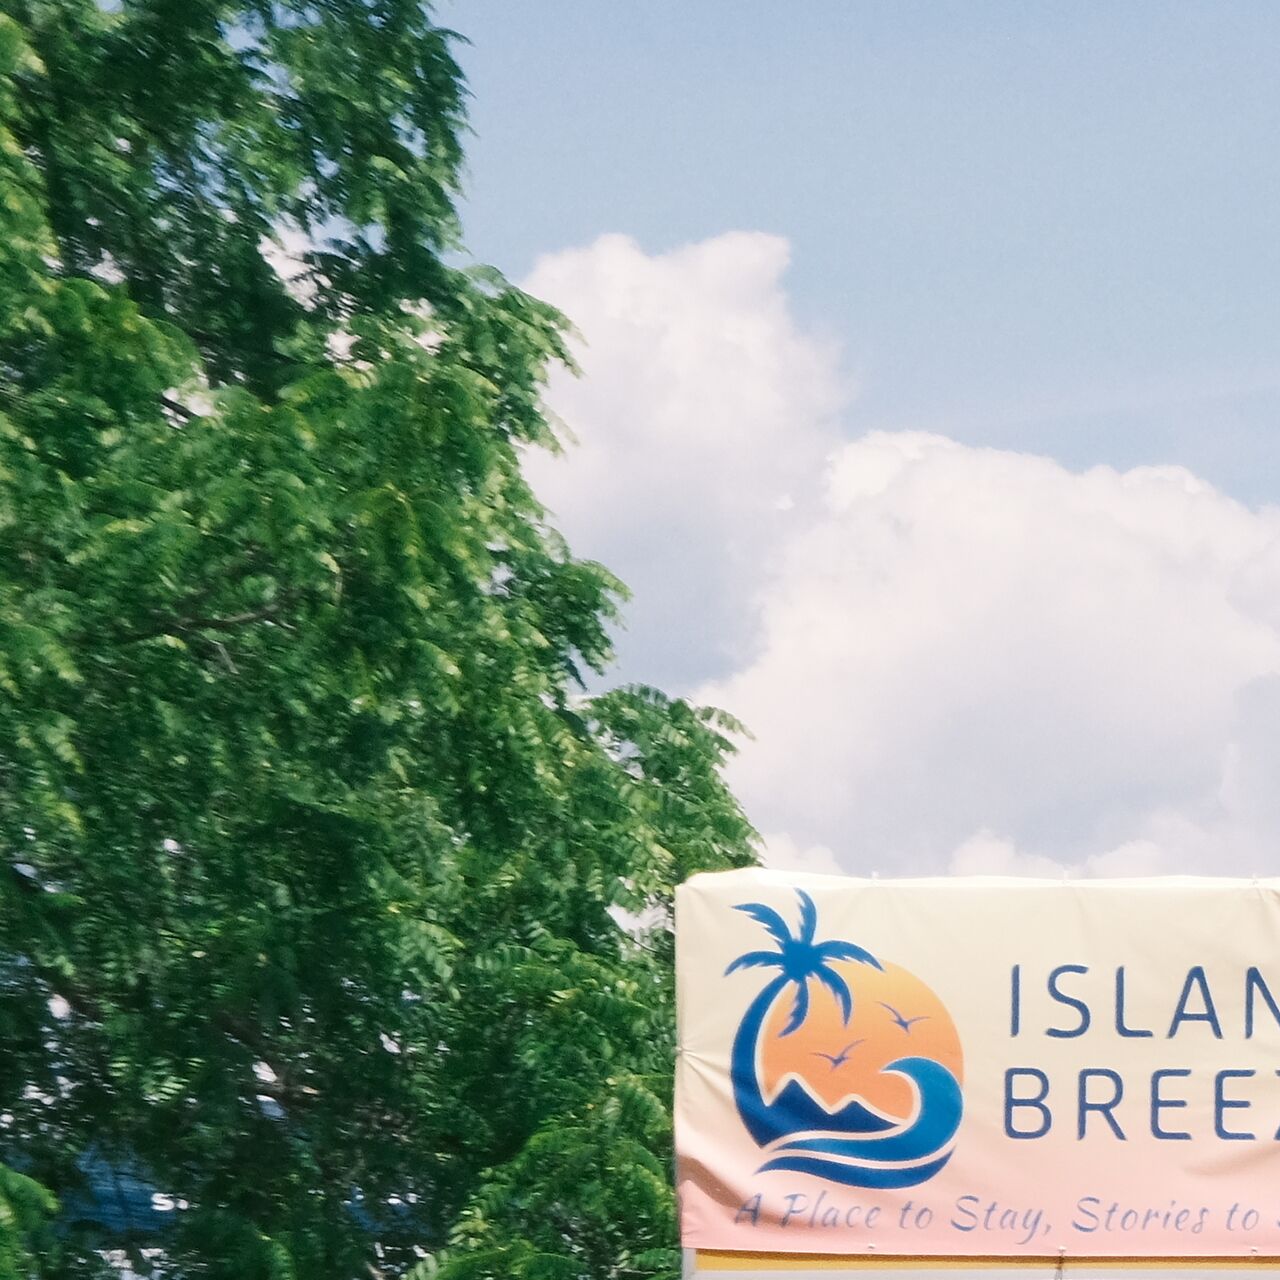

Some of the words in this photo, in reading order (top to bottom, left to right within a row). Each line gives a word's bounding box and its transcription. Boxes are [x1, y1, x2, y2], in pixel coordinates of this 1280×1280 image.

[734, 1192, 762, 1227] A
[778, 1190, 882, 1229] Place
[899, 1200, 933, 1230] to
[950, 1195, 1053, 1245] Stay,
[1071, 1196, 1209, 1234] Stories
[1225, 1202, 1260, 1232] to
